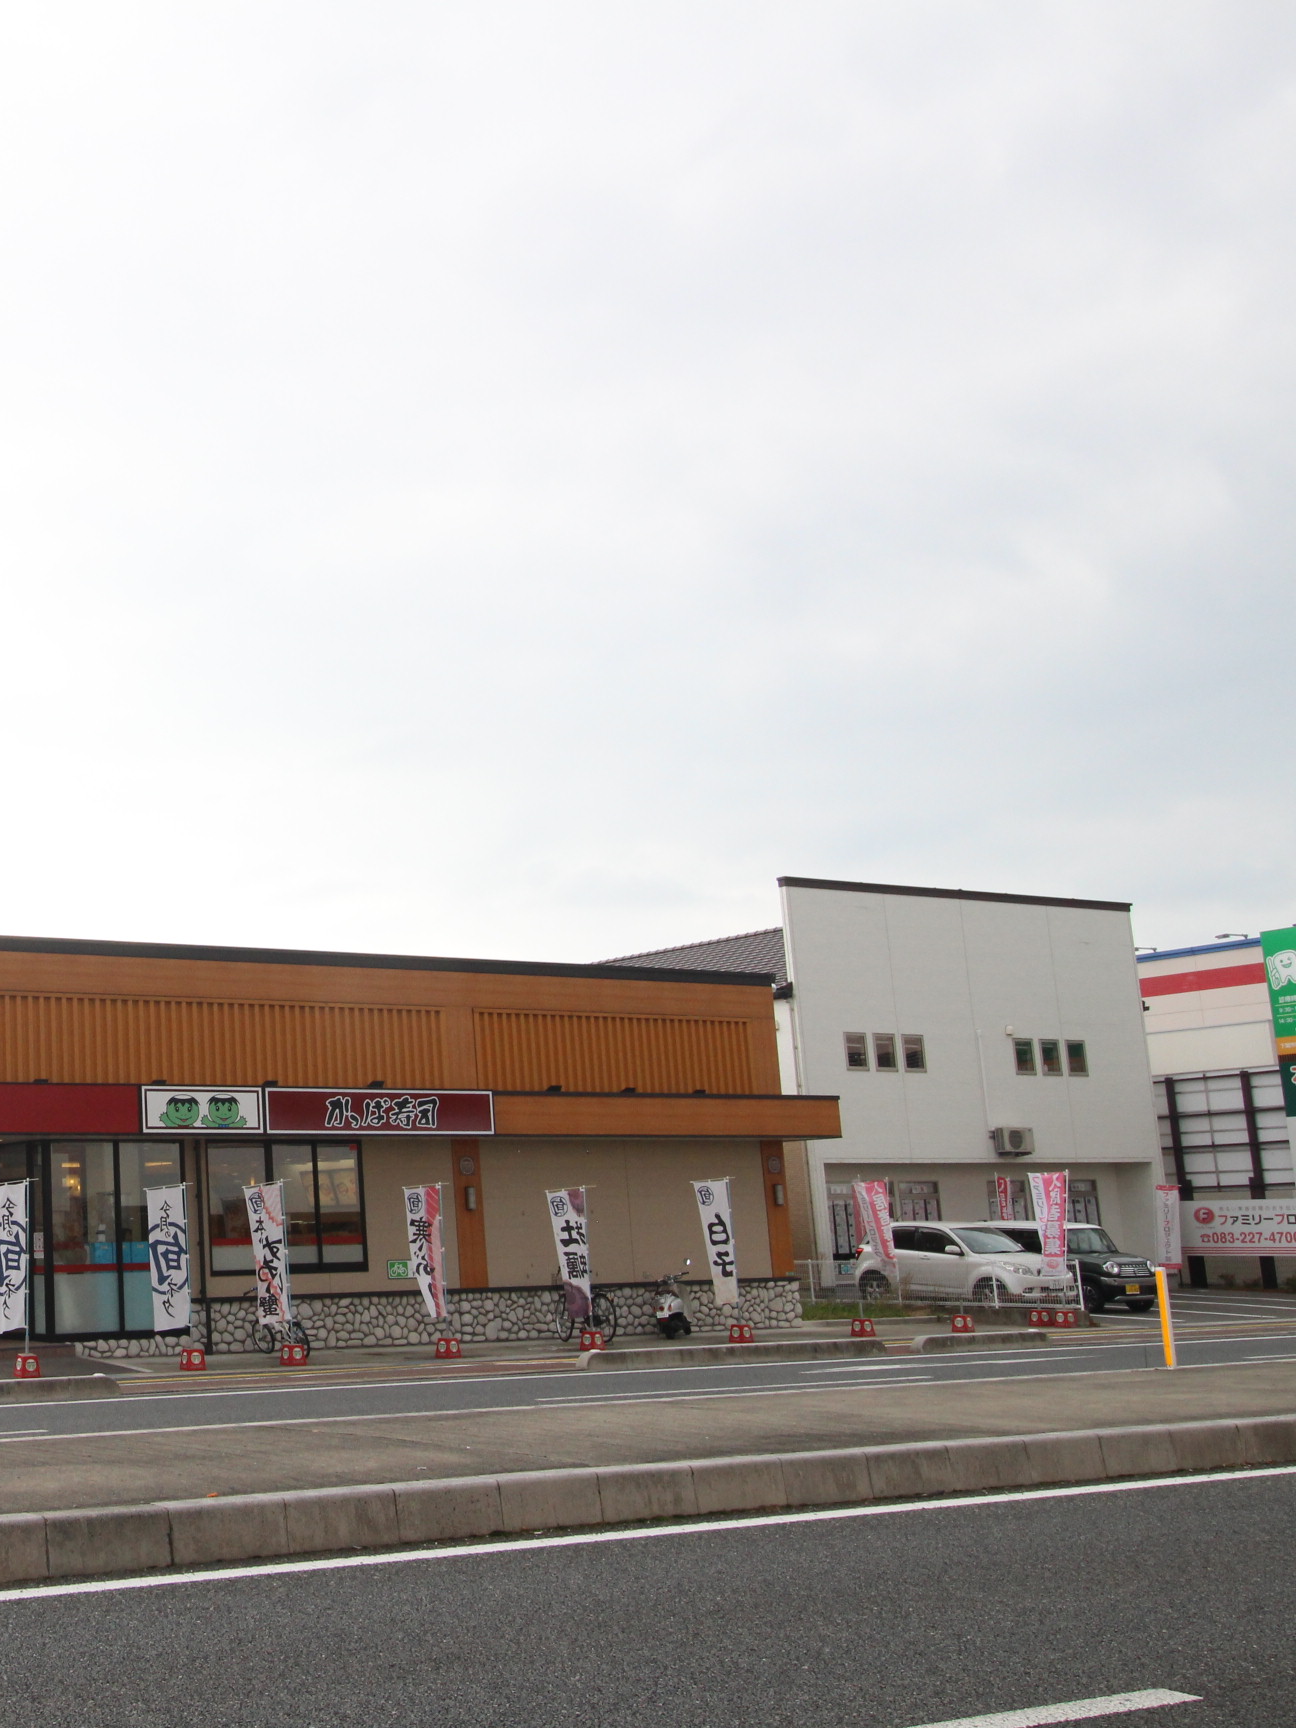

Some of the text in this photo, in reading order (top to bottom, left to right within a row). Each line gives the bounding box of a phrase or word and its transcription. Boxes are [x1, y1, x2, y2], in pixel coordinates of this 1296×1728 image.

[325, 1096, 440, 1129] かっぱ寿司
